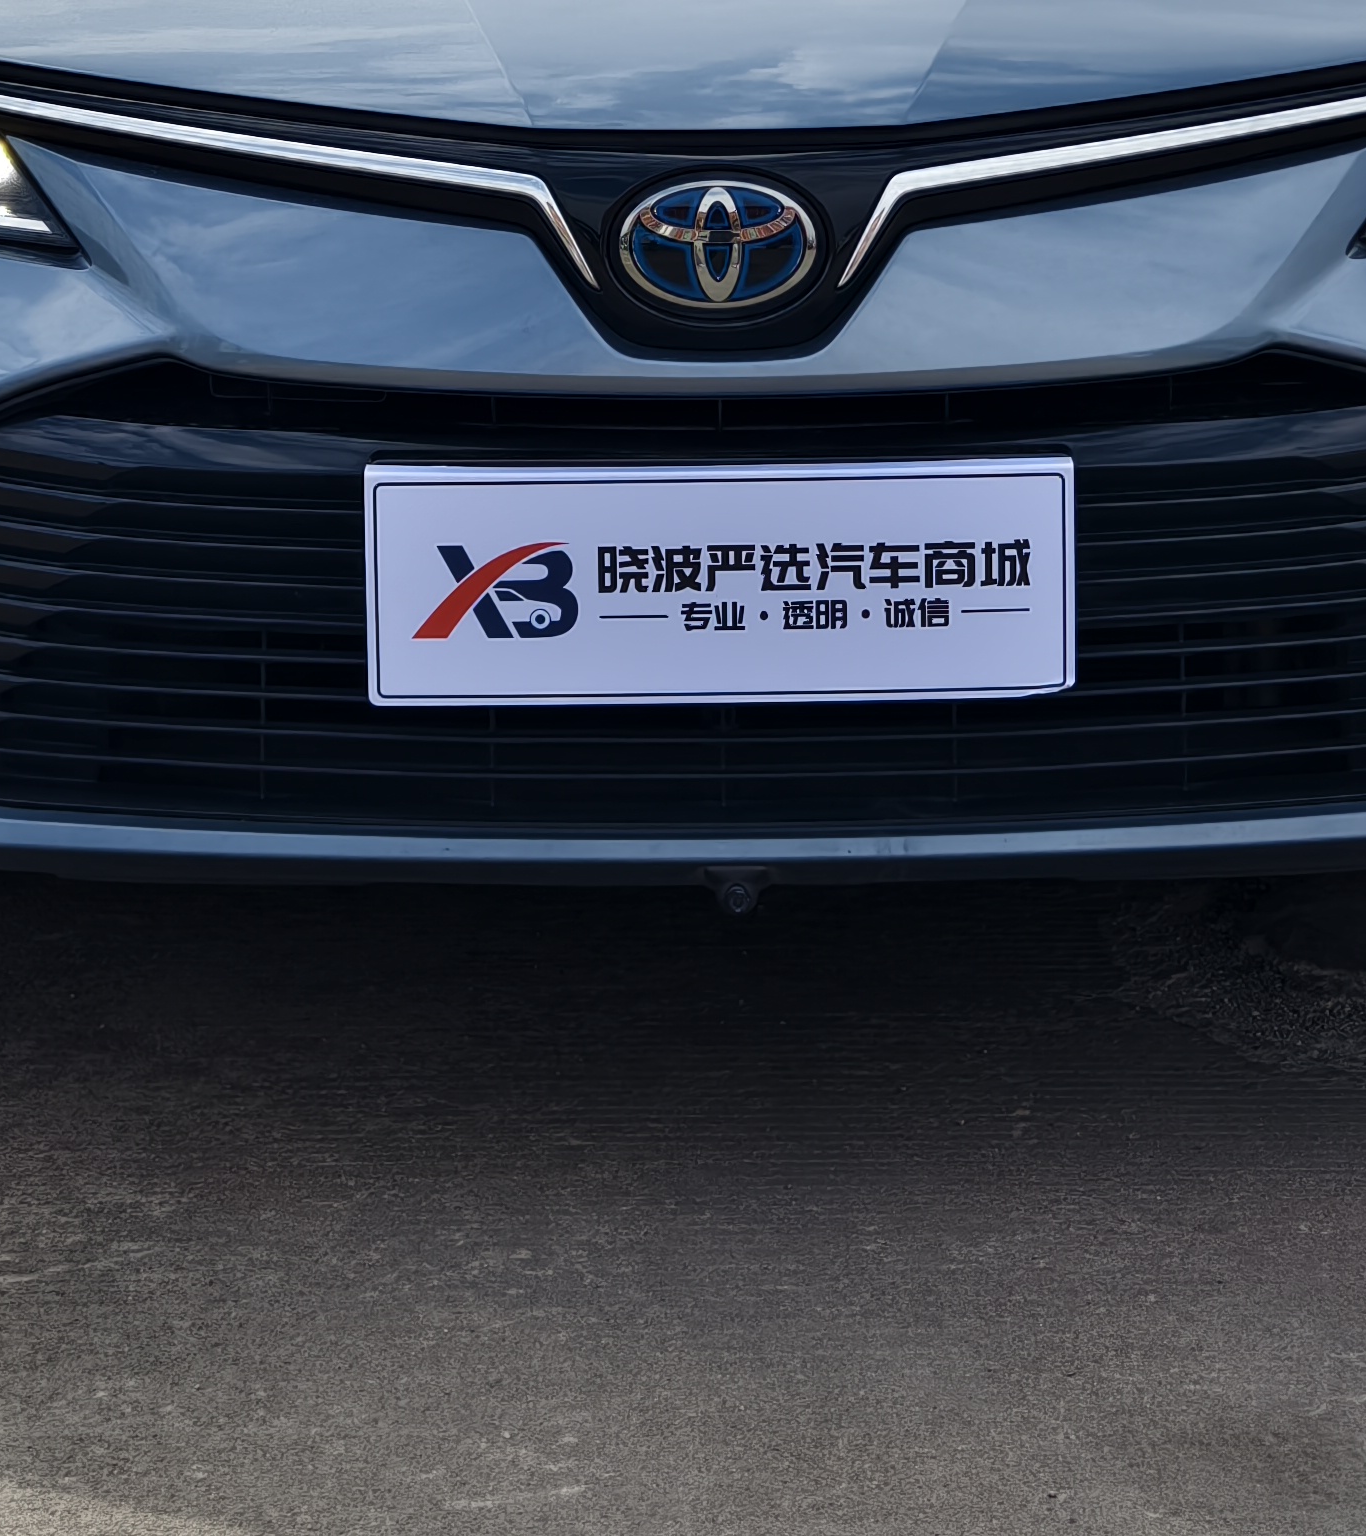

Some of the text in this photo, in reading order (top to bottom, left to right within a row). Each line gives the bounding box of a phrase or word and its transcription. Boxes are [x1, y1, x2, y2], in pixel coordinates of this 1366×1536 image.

[597, 538, 1031, 594] 晓波严选汽车商城
